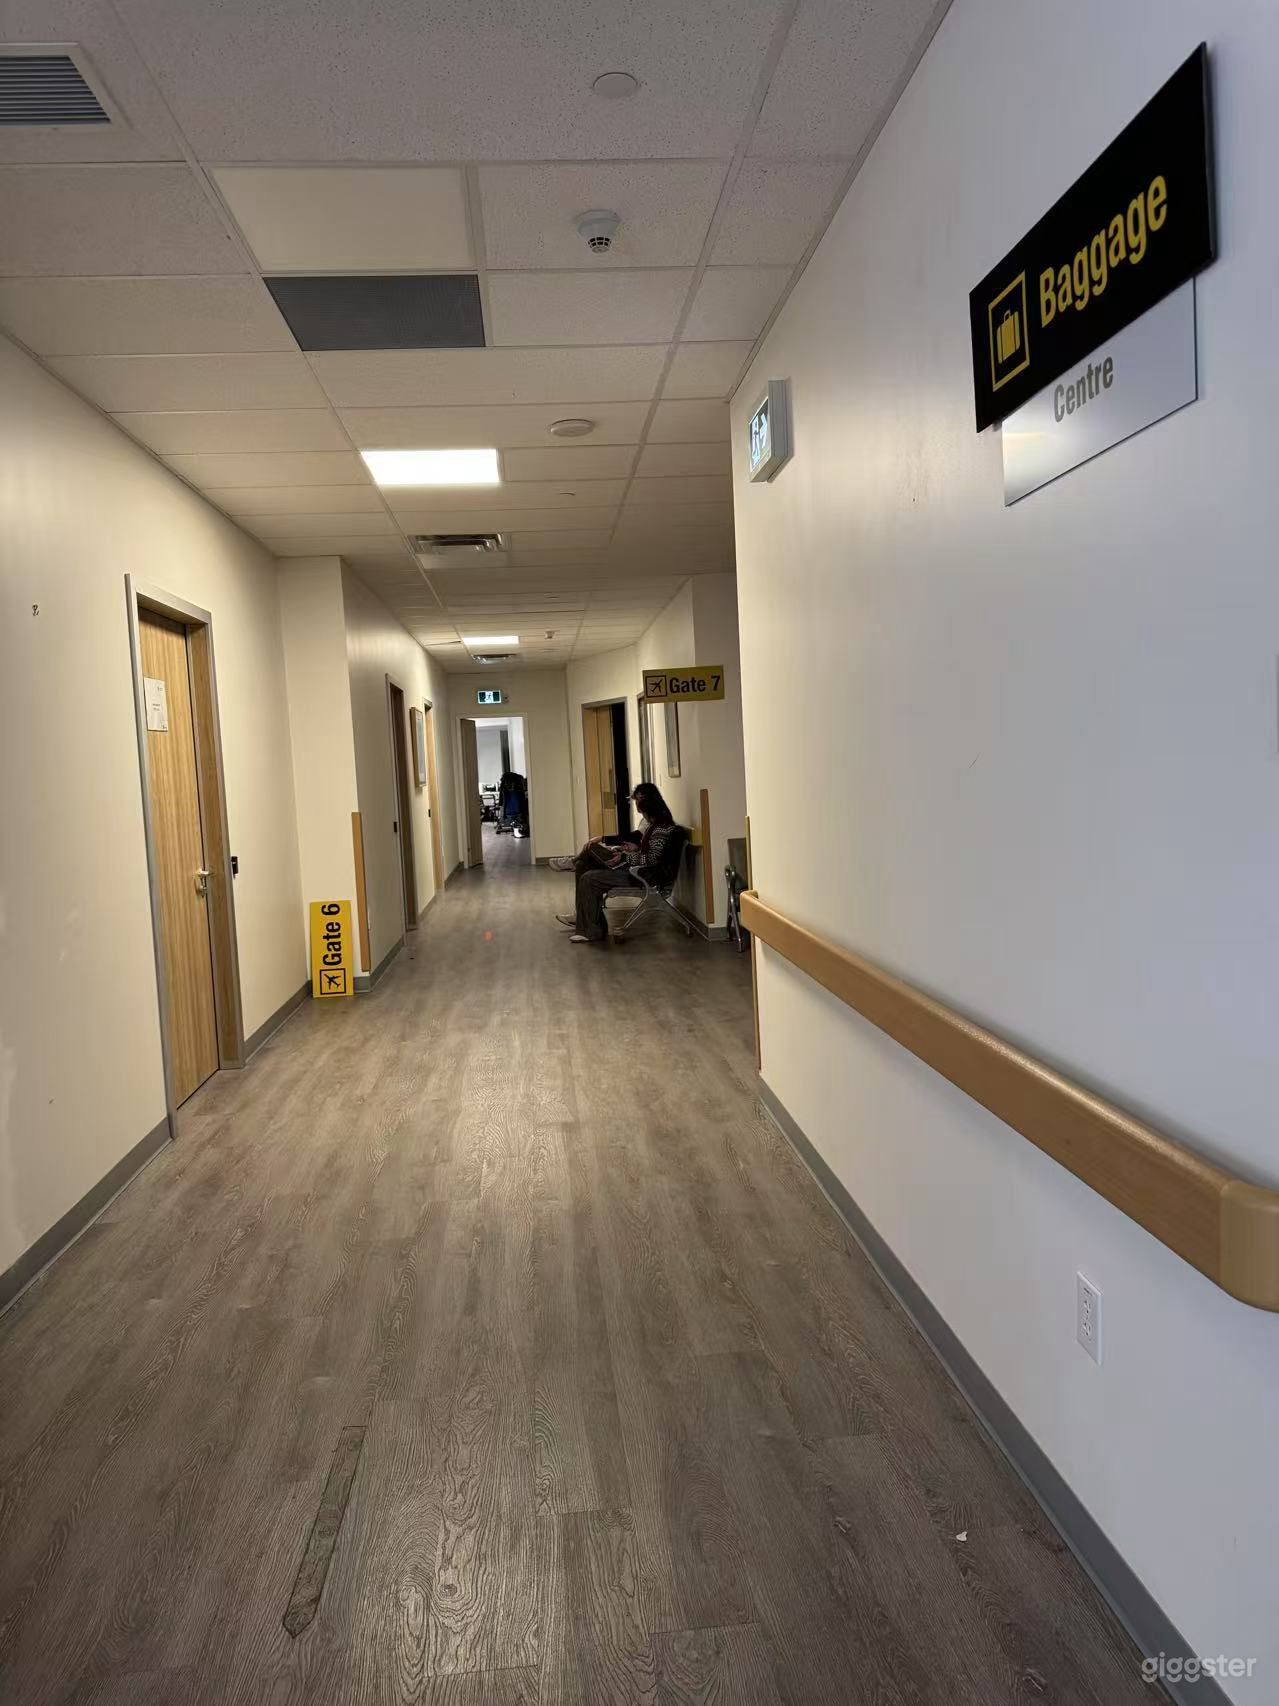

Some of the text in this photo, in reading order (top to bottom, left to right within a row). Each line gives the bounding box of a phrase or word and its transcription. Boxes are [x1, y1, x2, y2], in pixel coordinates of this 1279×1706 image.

[1039, 175, 1167, 328] Baggage
[1054, 356, 1113, 423] Centre
[669, 675, 720, 693] Gate 7
[321, 903, 342, 966] Gate 6
